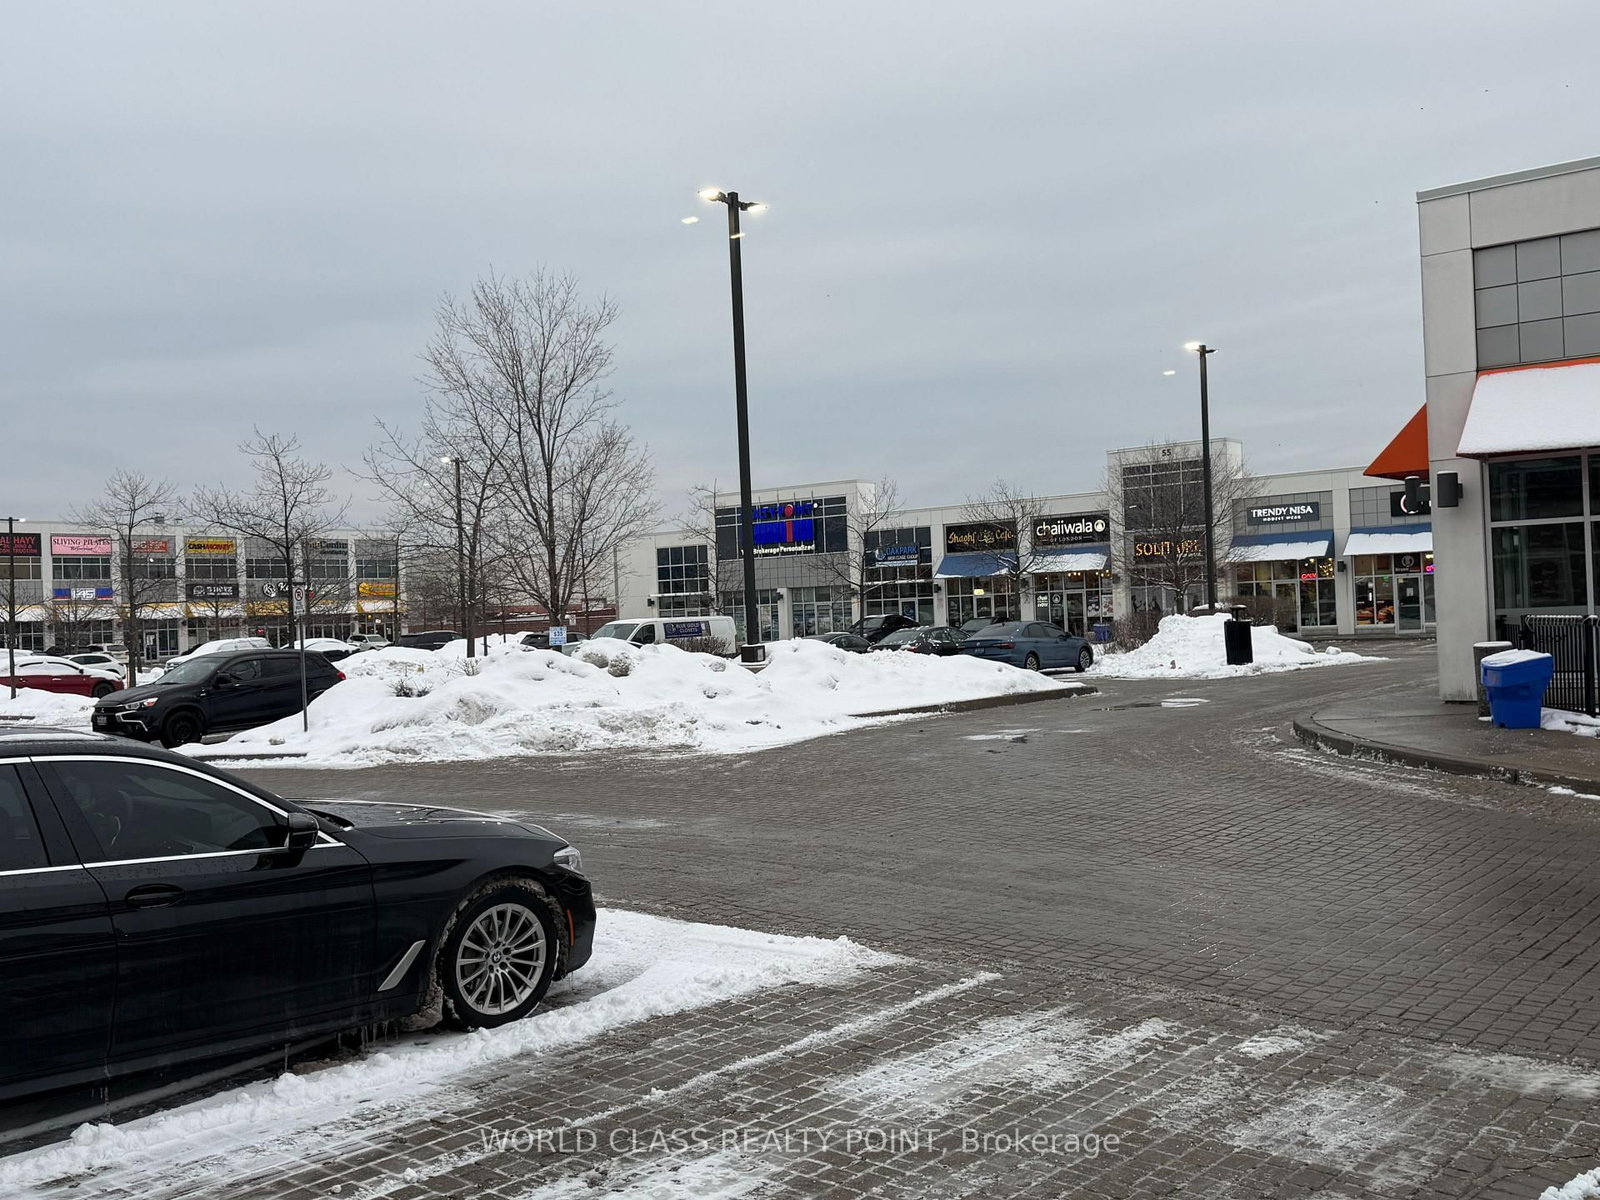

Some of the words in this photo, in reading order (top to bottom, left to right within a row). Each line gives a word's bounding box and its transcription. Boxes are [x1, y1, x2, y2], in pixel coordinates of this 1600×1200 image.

[1251, 507, 1288, 517] TRENDY
[1289, 506, 1313, 515] NISA
[1036, 518, 1093, 536] chaiiwala
[13, 536, 36, 544] HAYY
[53, 538, 81, 546] SLIVING
[886, 546, 917, 555] OAKPARK
